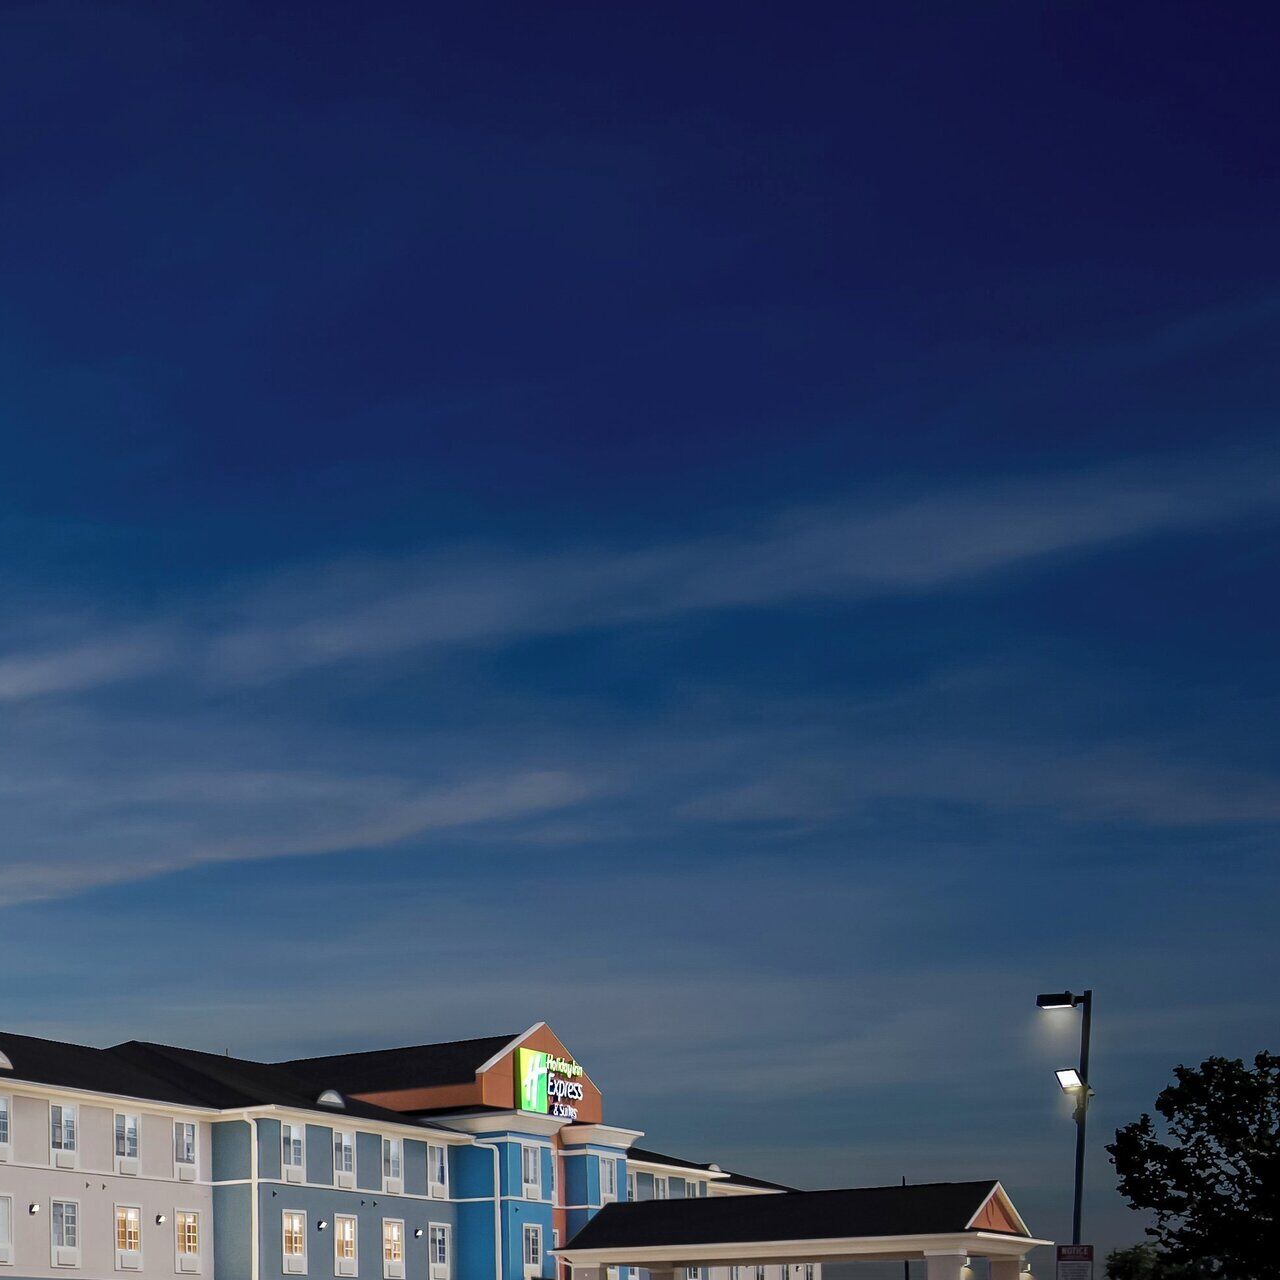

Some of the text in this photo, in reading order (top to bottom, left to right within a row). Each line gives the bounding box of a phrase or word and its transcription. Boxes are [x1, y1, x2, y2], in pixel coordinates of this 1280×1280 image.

[546, 1054, 583, 1078] Holiday Inn
[547, 1072, 583, 1101] Express
[559, 1104, 578, 1119] Suites
[1061, 1247, 1088, 1255] NOTICE
